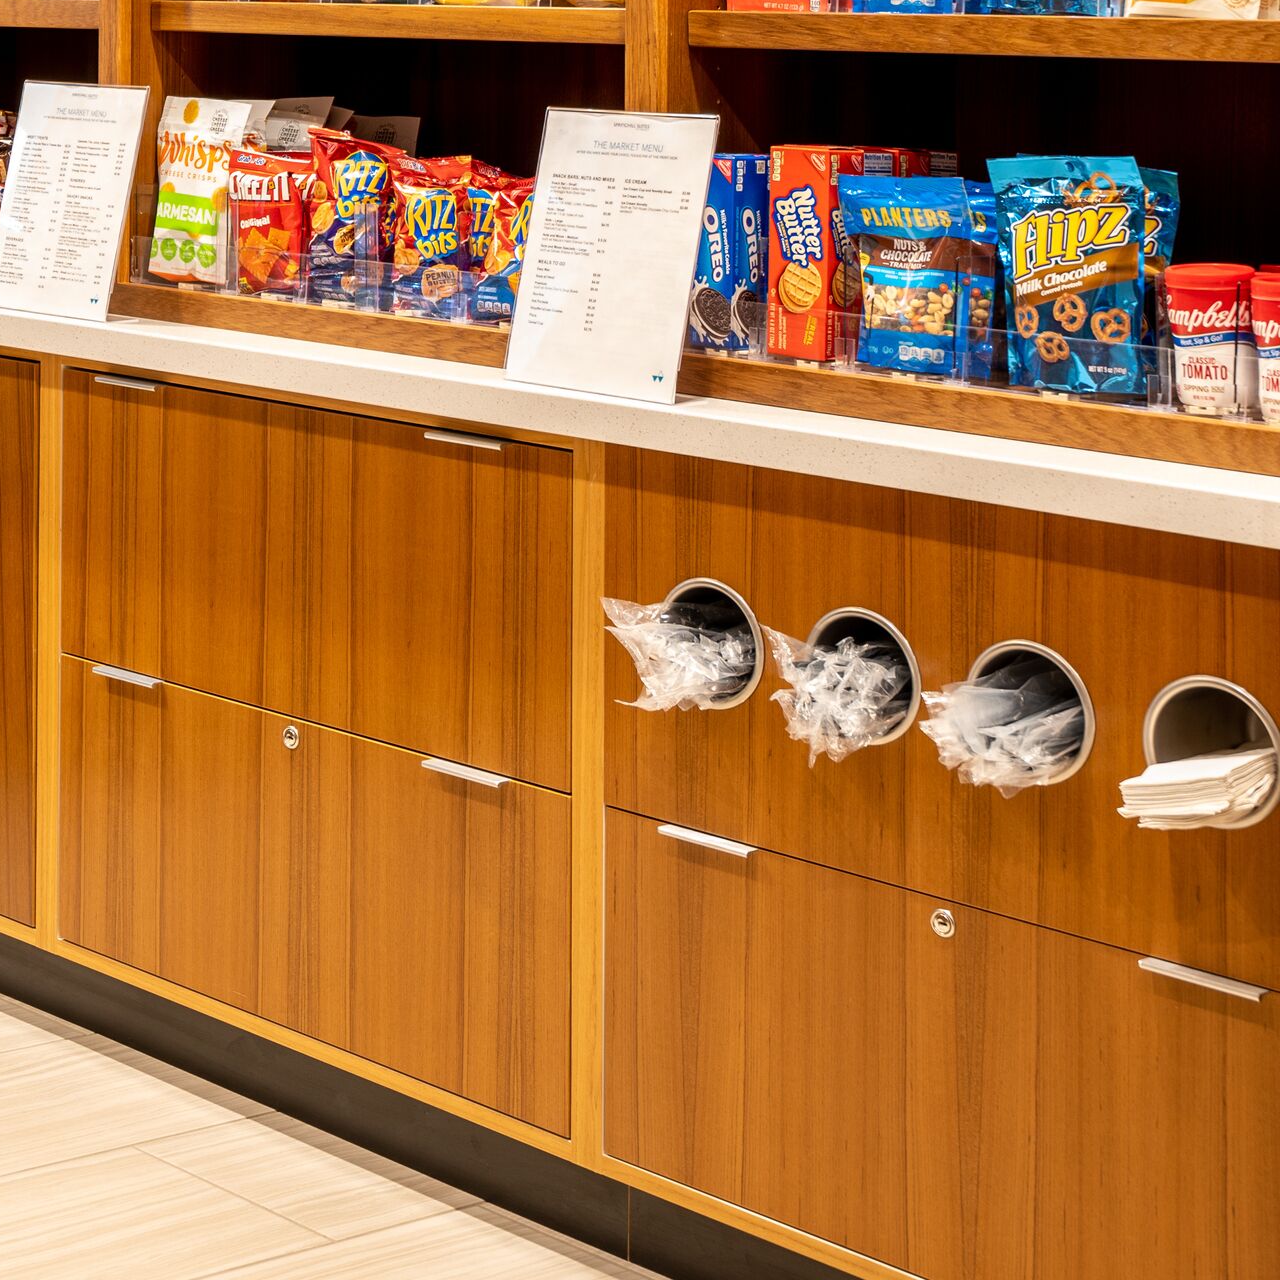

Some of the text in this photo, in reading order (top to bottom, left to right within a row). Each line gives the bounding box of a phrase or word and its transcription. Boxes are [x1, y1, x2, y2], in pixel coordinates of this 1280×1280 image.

[68, 109, 89, 117] MARKET
[159, 130, 233, 172] Whisps
[594, 140, 663, 153] THE MARKET MENU
[335, 161, 388, 196] RITZ
[157, 203, 216, 226] ARMESAN
[407, 195, 455, 237] RITZ
[793, 188, 821, 260] Nutter
[861, 207, 952, 228] PLANTERS
[775, 198, 807, 268] Butter
[417, 231, 458, 259] bits
[703, 206, 723, 282] OREO
[743, 209, 757, 282] OREO
[893, 239, 927, 251] NUTS &
[880, 250, 933, 262] CHOCOLATE
[425, 272, 455, 281] PEANUT
[1016, 260, 1107, 297] Milk Chocolate
[1041, 281, 1083, 296] Covered Pretzels
[1193, 334, 1229, 346] Sip Go!
[1188, 357, 1216, 365] CLASSIC
[1182, 364, 1228, 381] TOMATO
[1183, 384, 1209, 393] SIPPING
